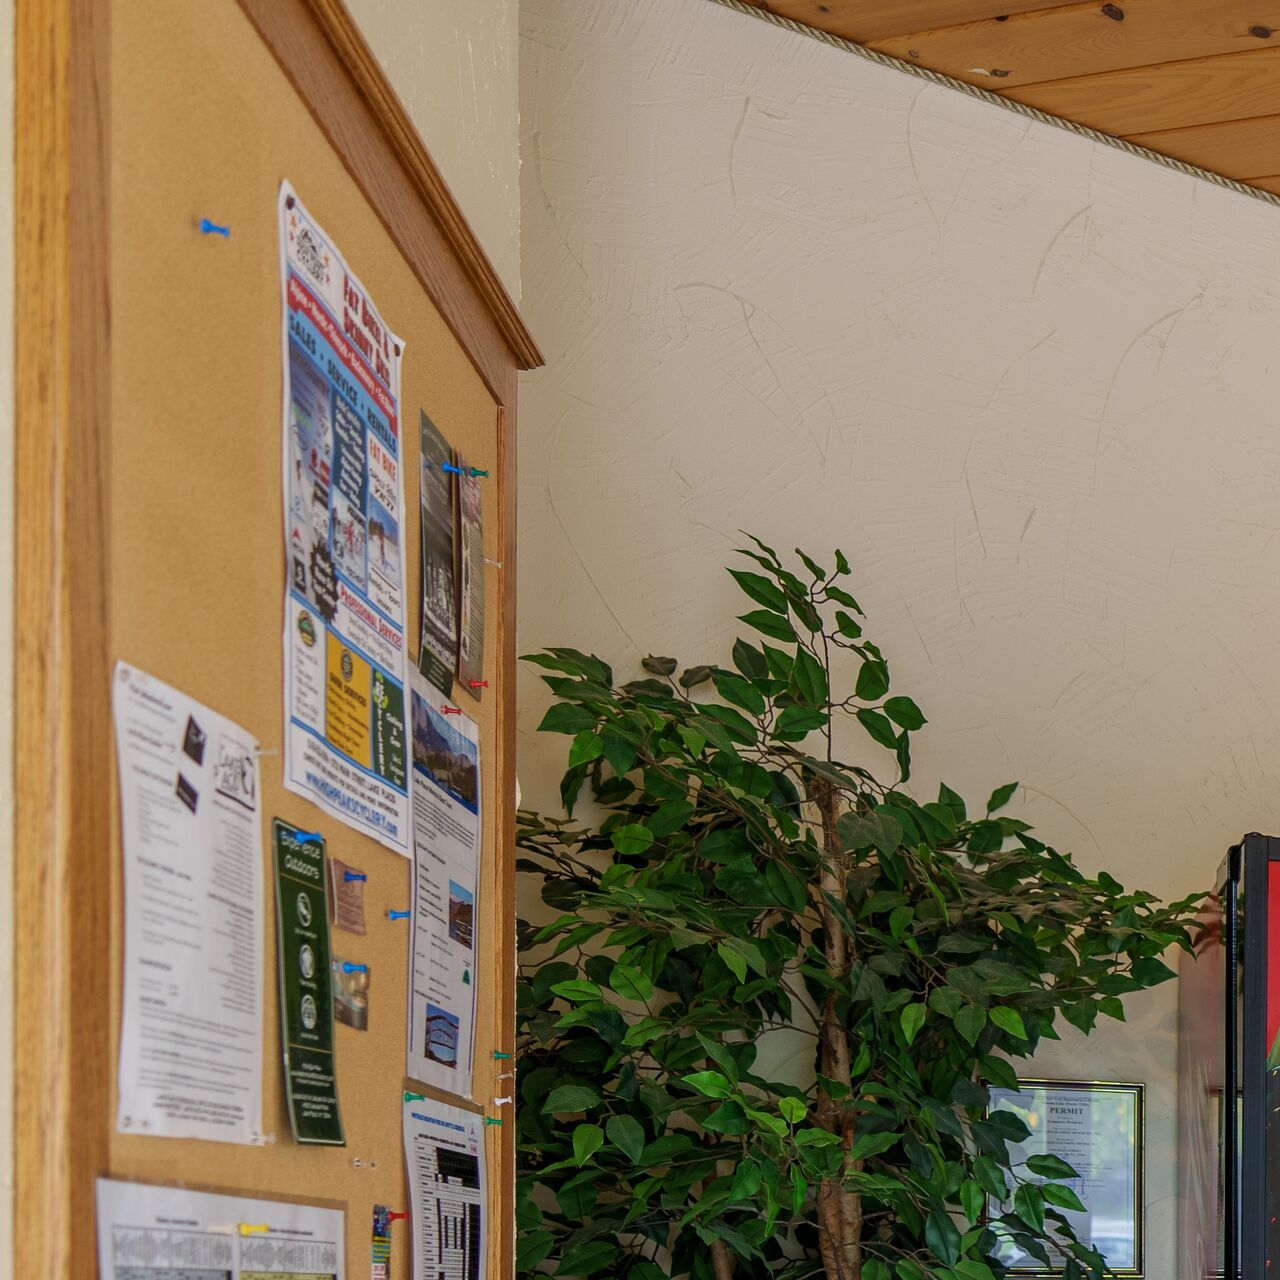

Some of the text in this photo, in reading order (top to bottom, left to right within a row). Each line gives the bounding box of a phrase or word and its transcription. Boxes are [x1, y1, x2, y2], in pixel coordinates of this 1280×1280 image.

[344, 272, 359, 316] FAT
[289, 314, 317, 356] SALES
[327, 359, 358, 406] SERVICE
[367, 407, 397, 453] RENTALS
[370, 438, 380, 465] FAT
[383, 453, 396, 482] BIKE
[341, 584, 378, 630] PROFESSIONAL
[378, 618, 402, 649] SERVICES
[344, 685, 367, 707] SERVICES
[284, 854, 320, 880] Outdoors
[1050, 1107, 1084, 1115] PERMIT
